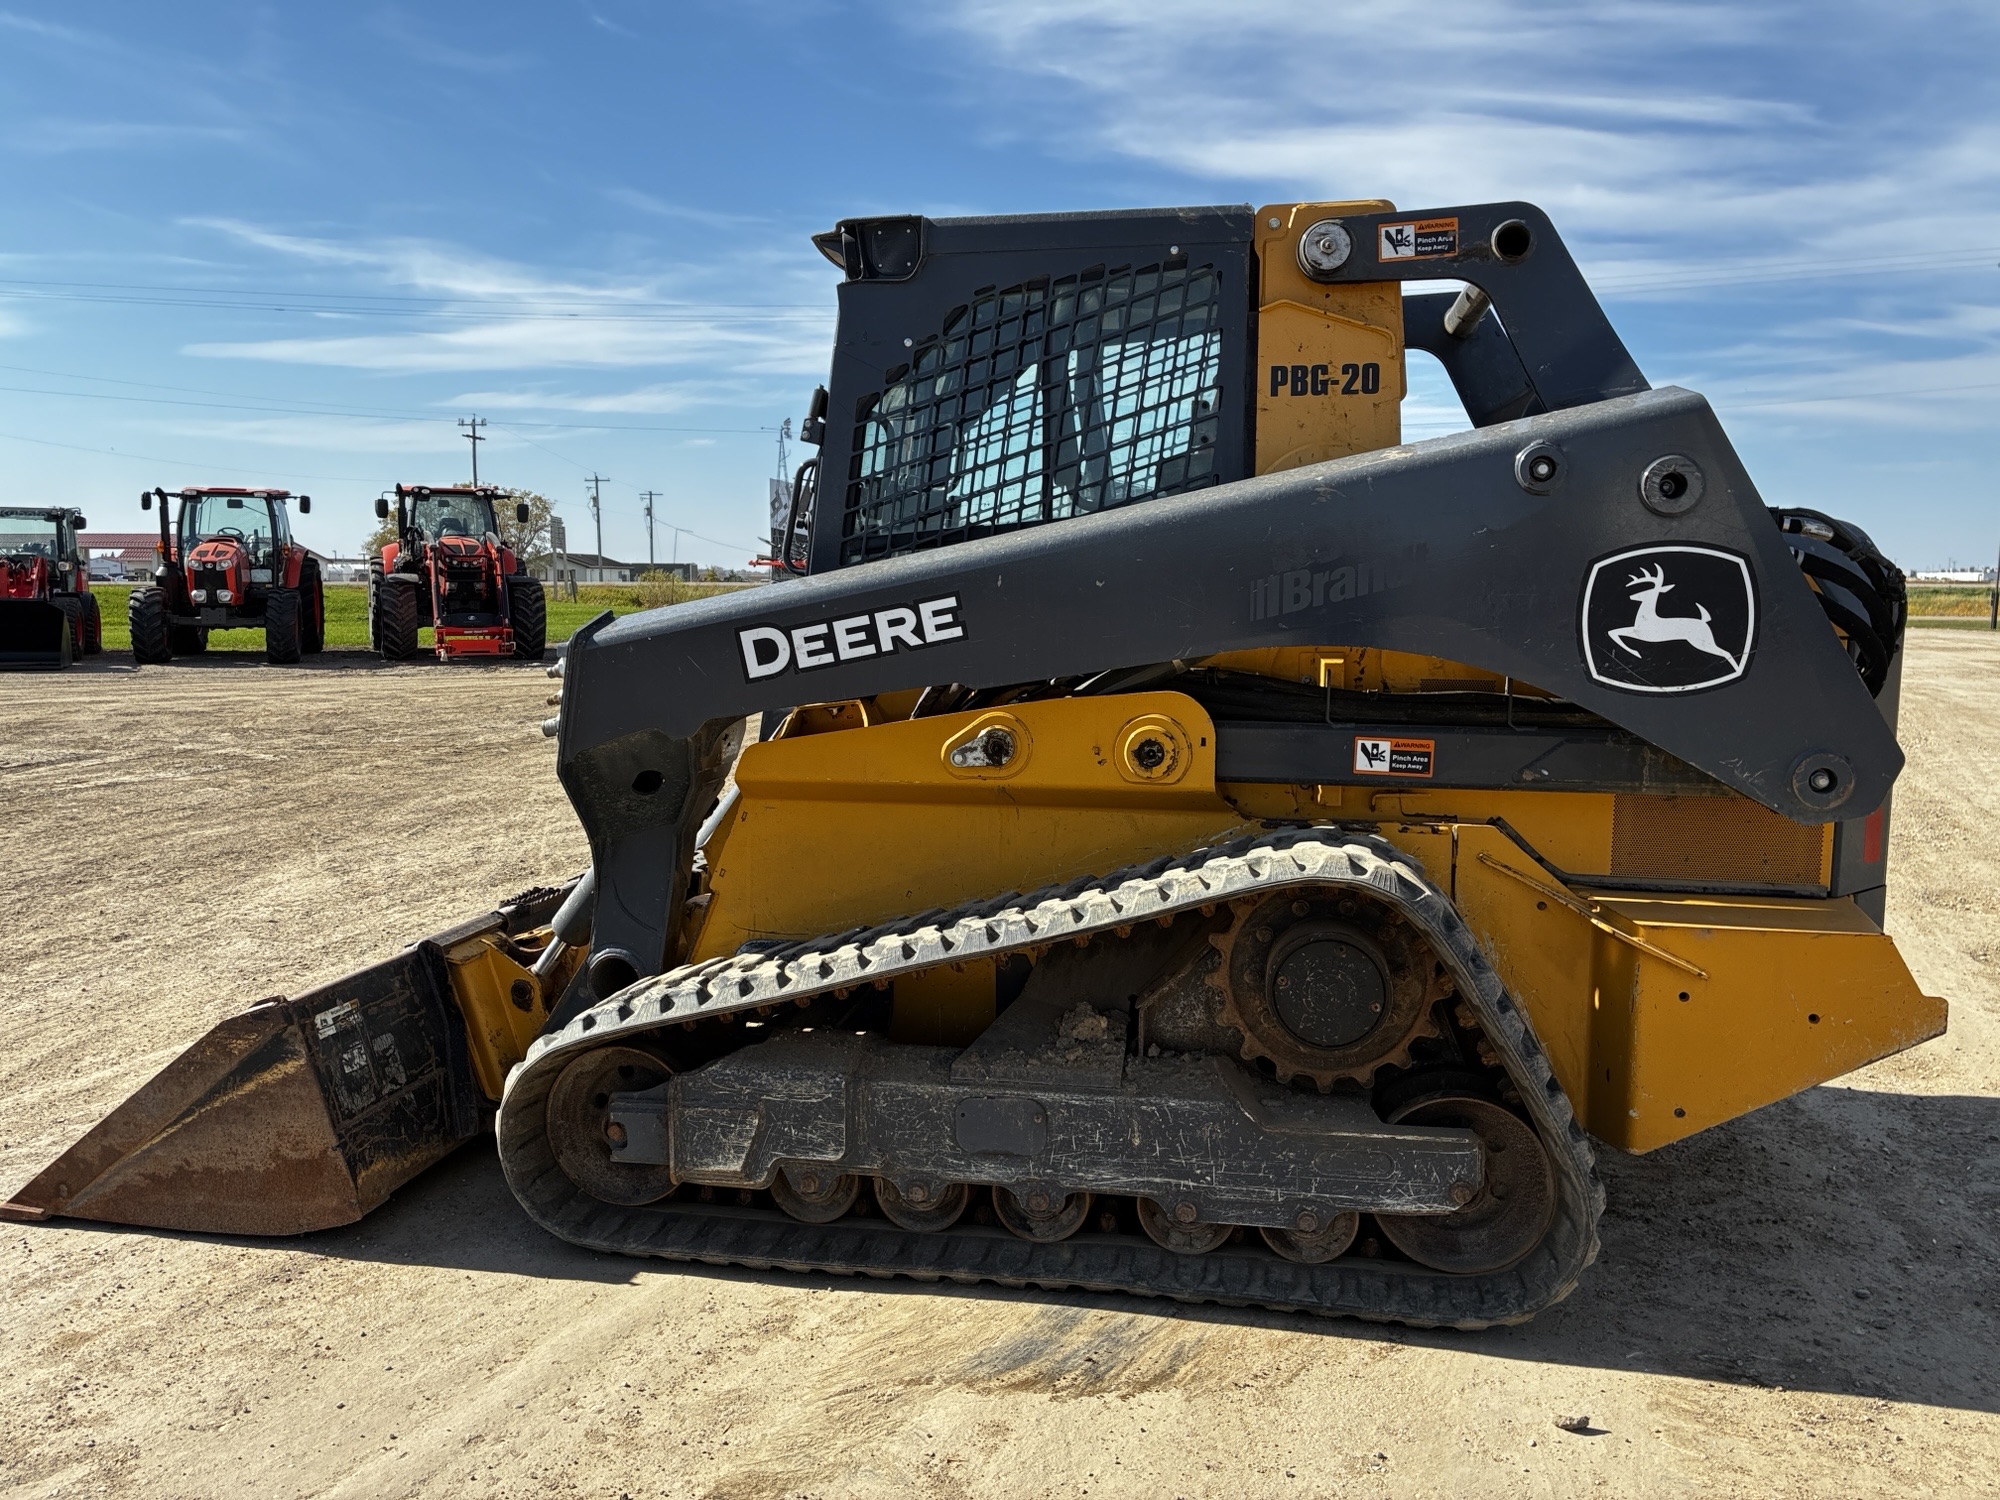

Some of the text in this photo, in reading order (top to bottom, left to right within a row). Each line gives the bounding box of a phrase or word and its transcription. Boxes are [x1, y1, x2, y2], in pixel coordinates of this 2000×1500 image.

[1417, 236, 1436, 244] Pinch
[1270, 362, 1380, 397] PBG-20
[739, 596, 964, 679] DEERE
